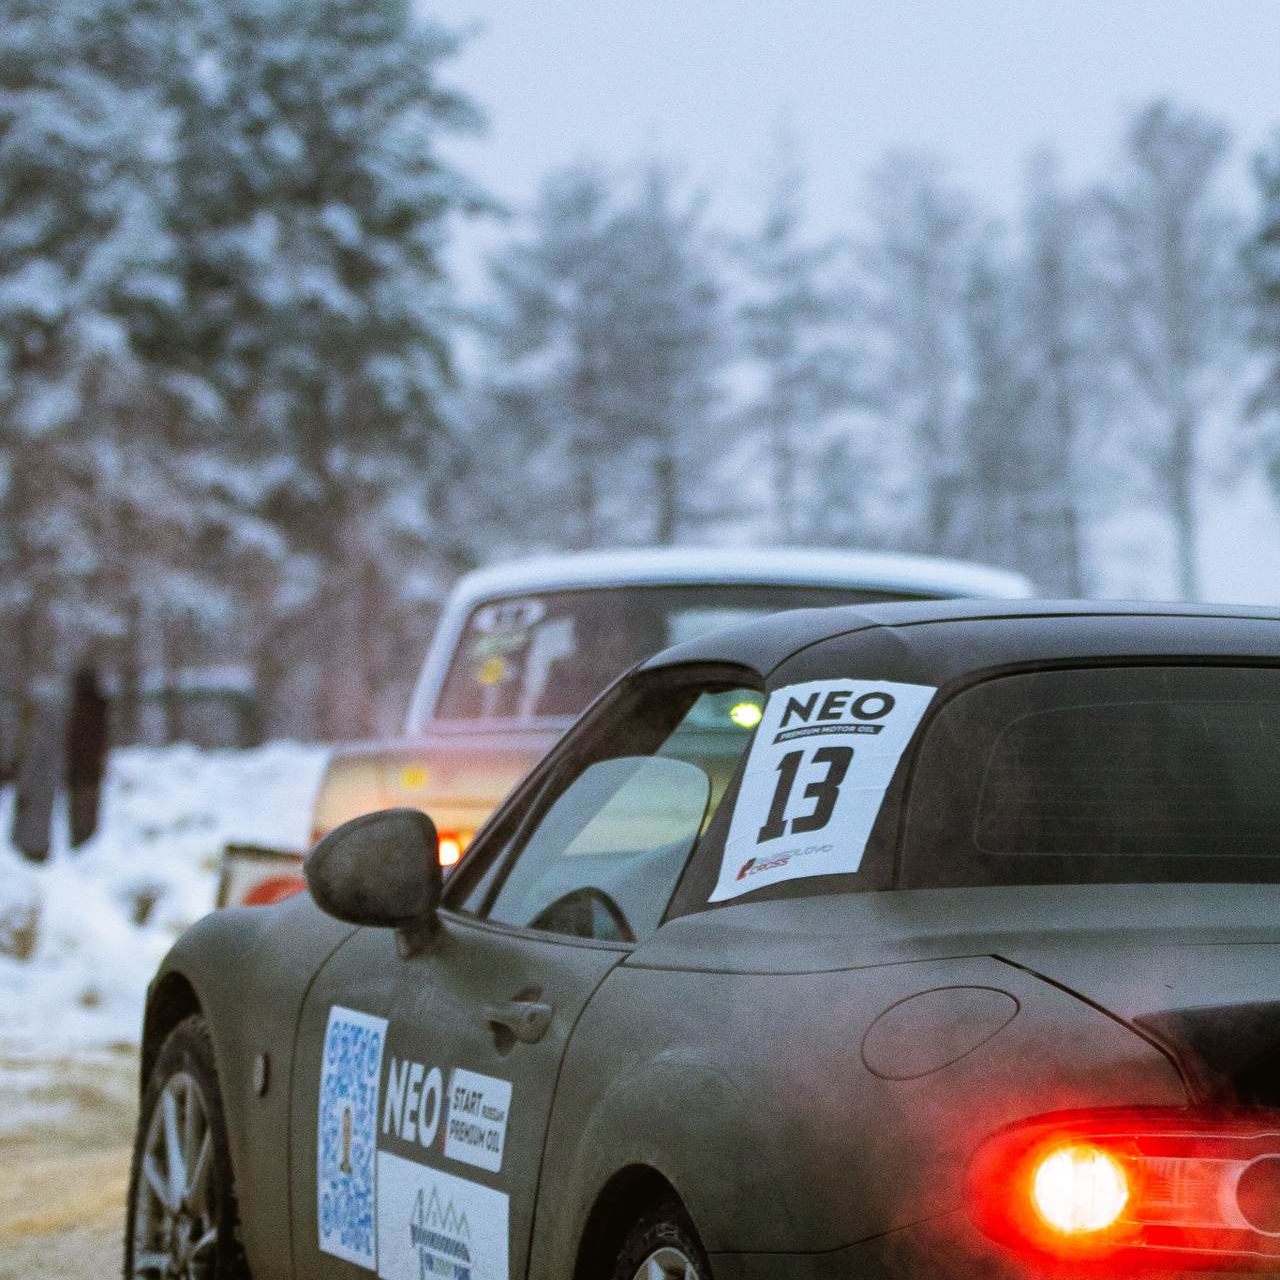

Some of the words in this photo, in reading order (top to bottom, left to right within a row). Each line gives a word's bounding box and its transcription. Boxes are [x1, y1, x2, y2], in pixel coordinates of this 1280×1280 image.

[779, 690, 896, 729] NEO
[780, 727, 820, 740] PREMIUM
[821, 725, 856, 735] MOTOR
[857, 725, 875, 734] OIL
[756, 746, 855, 845] 13
[382, 1056, 443, 1148] NEO
[453, 1087, 484, 1117] START
[486, 1129, 501, 1153] OIL
